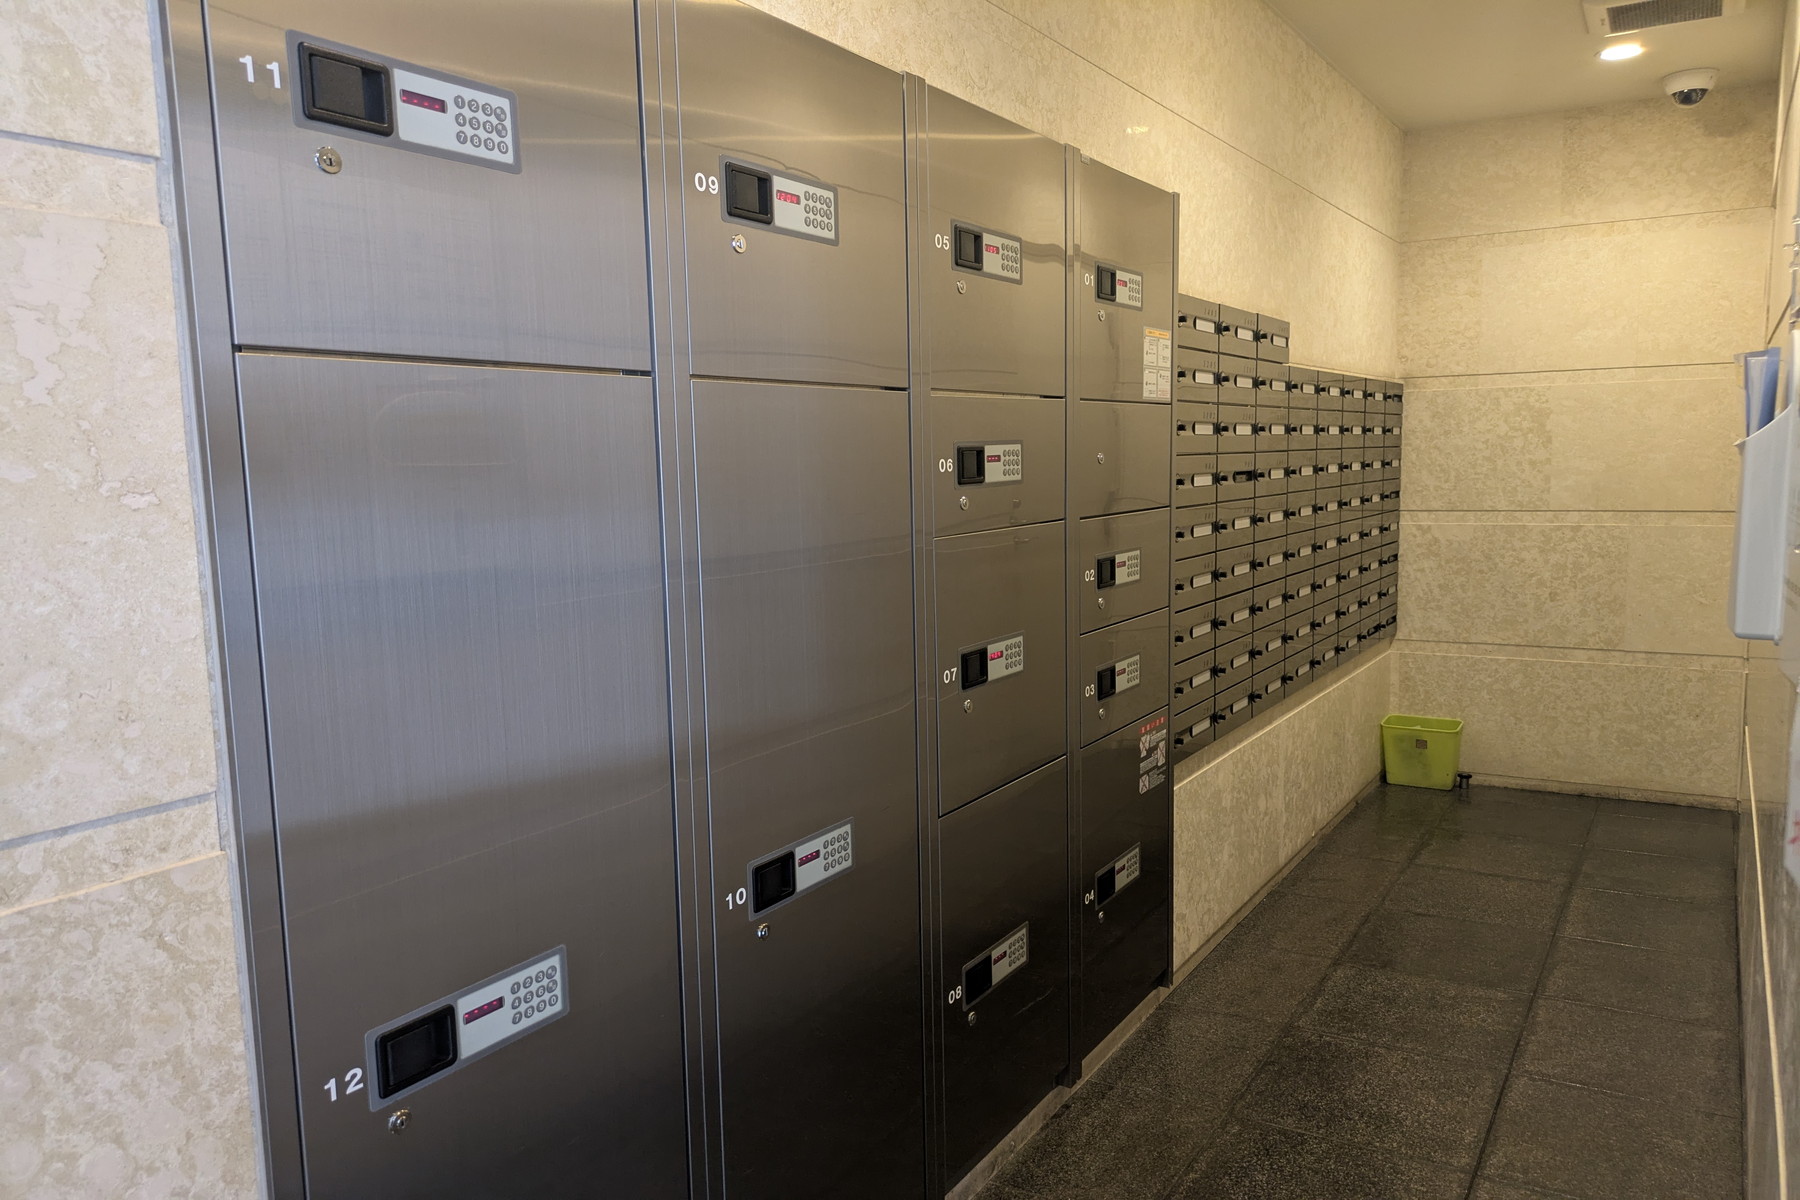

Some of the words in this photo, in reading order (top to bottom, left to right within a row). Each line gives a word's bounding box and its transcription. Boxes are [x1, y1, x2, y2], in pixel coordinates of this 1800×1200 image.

[239, 55, 281, 89] 11
[694, 172, 719, 195] 09
[934, 233, 950, 251] 05
[1084, 273, 1094, 287] 01
[938, 458, 954, 473] 06
[1084, 569, 1095, 582] 02
[943, 667, 958, 684] 07
[1084, 683, 1095, 698] 03
[725, 887, 747, 911] 10
[1084, 889, 1095, 905] 04
[948, 985, 962, 1005] 08
[323, 1067, 365, 1102] 12
